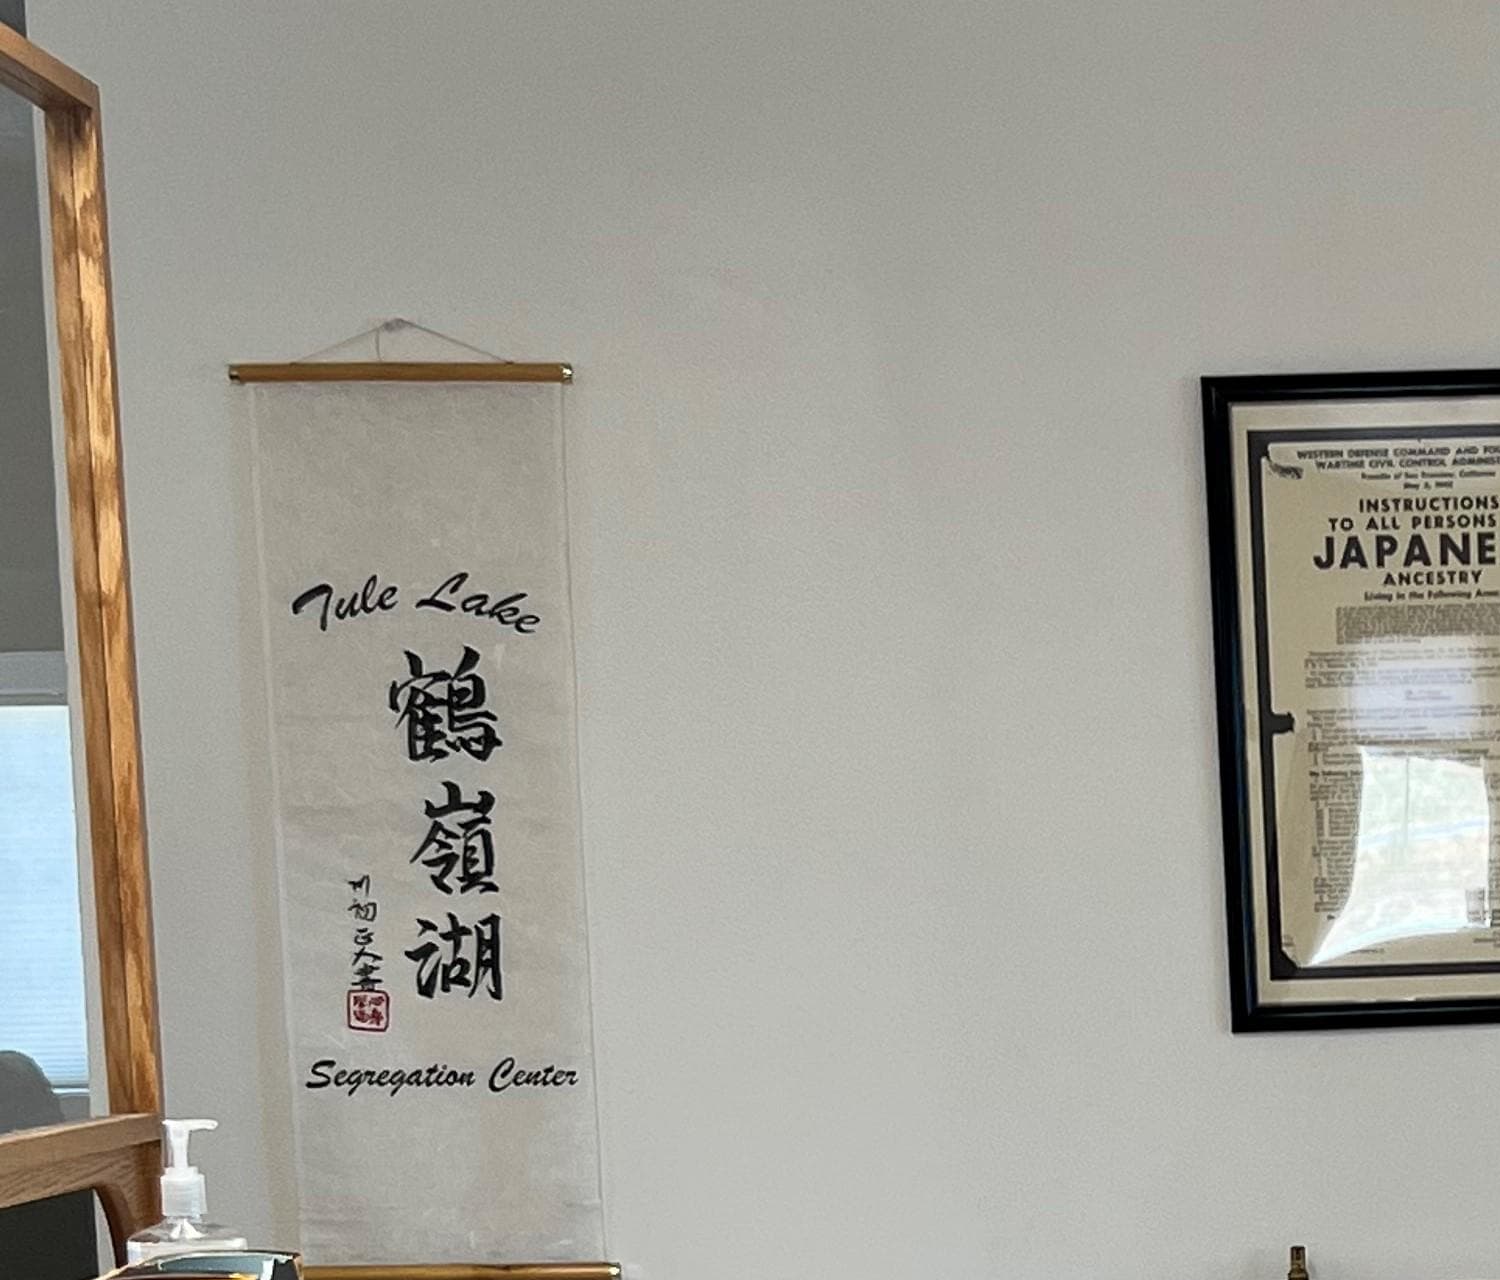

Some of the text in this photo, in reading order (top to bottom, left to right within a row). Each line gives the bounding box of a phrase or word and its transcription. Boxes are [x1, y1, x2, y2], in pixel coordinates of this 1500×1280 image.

[1297, 449, 1343, 459] WESTERN
[1347, 448, 1388, 458] DEFENSE
[1393, 447, 1450, 457] COMMAND
[1455, 446, 1479, 455] AND
[1315, 460, 1364, 470] WARTIME
[1368, 459, 1395, 469] CIVIL
[1399, 458, 1447, 468] CONTROL
[1359, 496, 1499, 513] INSTRUCTIONS
[1329, 517, 1354, 532] TO
[1365, 516, 1400, 531] ALL
[1412, 514, 1496, 529] PERSONS
[1383, 570, 1483, 586] ANCESTRY
[292, 572, 541, 634] Tule Lake
[1364, 590, 1393, 602] Living
[1396, 590, 1406, 600] in
[1408, 589, 1425, 600] the
[1428, 588, 1472, 601] Following
[305, 1057, 579, 1096] Segregation Center
